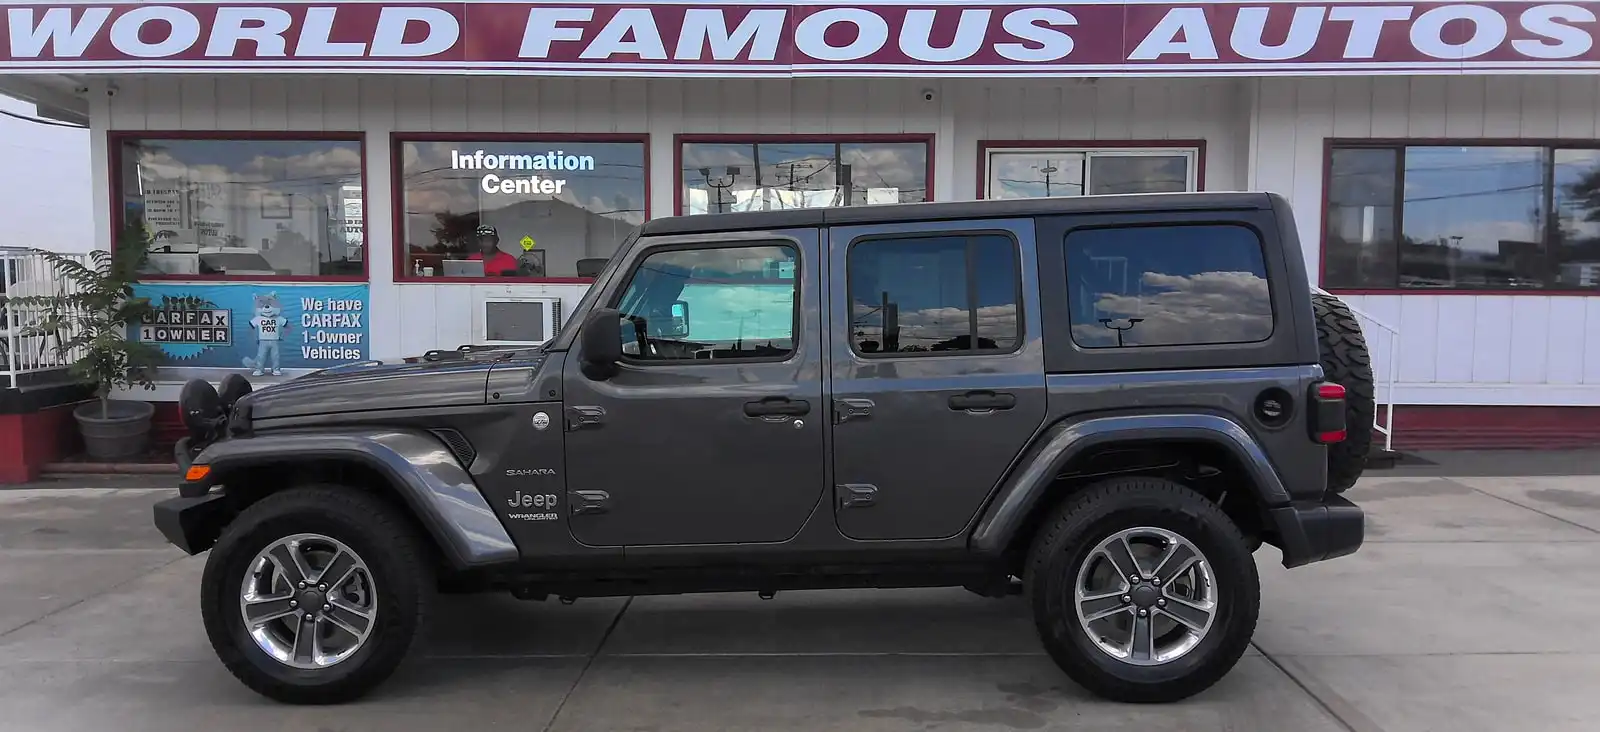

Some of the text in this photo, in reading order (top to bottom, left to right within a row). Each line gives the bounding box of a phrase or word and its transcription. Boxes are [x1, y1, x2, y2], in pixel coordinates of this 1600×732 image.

[7, 4, 1598, 62] WORLD FAMOUS AUTOS
[451, 150, 595, 171] Information
[481, 174, 567, 194] Center
[301, 297, 362, 311] We have
[260, 319, 277, 327] CAR
[301, 313, 362, 328] CARFAX
[157, 328, 226, 341] OWNER
[261, 325, 277, 333] FOX
[301, 330, 363, 344] 1-Owner
[301, 346, 361, 360] Vehicles
[506, 468, 556, 476] SAHARA
[508, 490, 558, 510] Jeep
